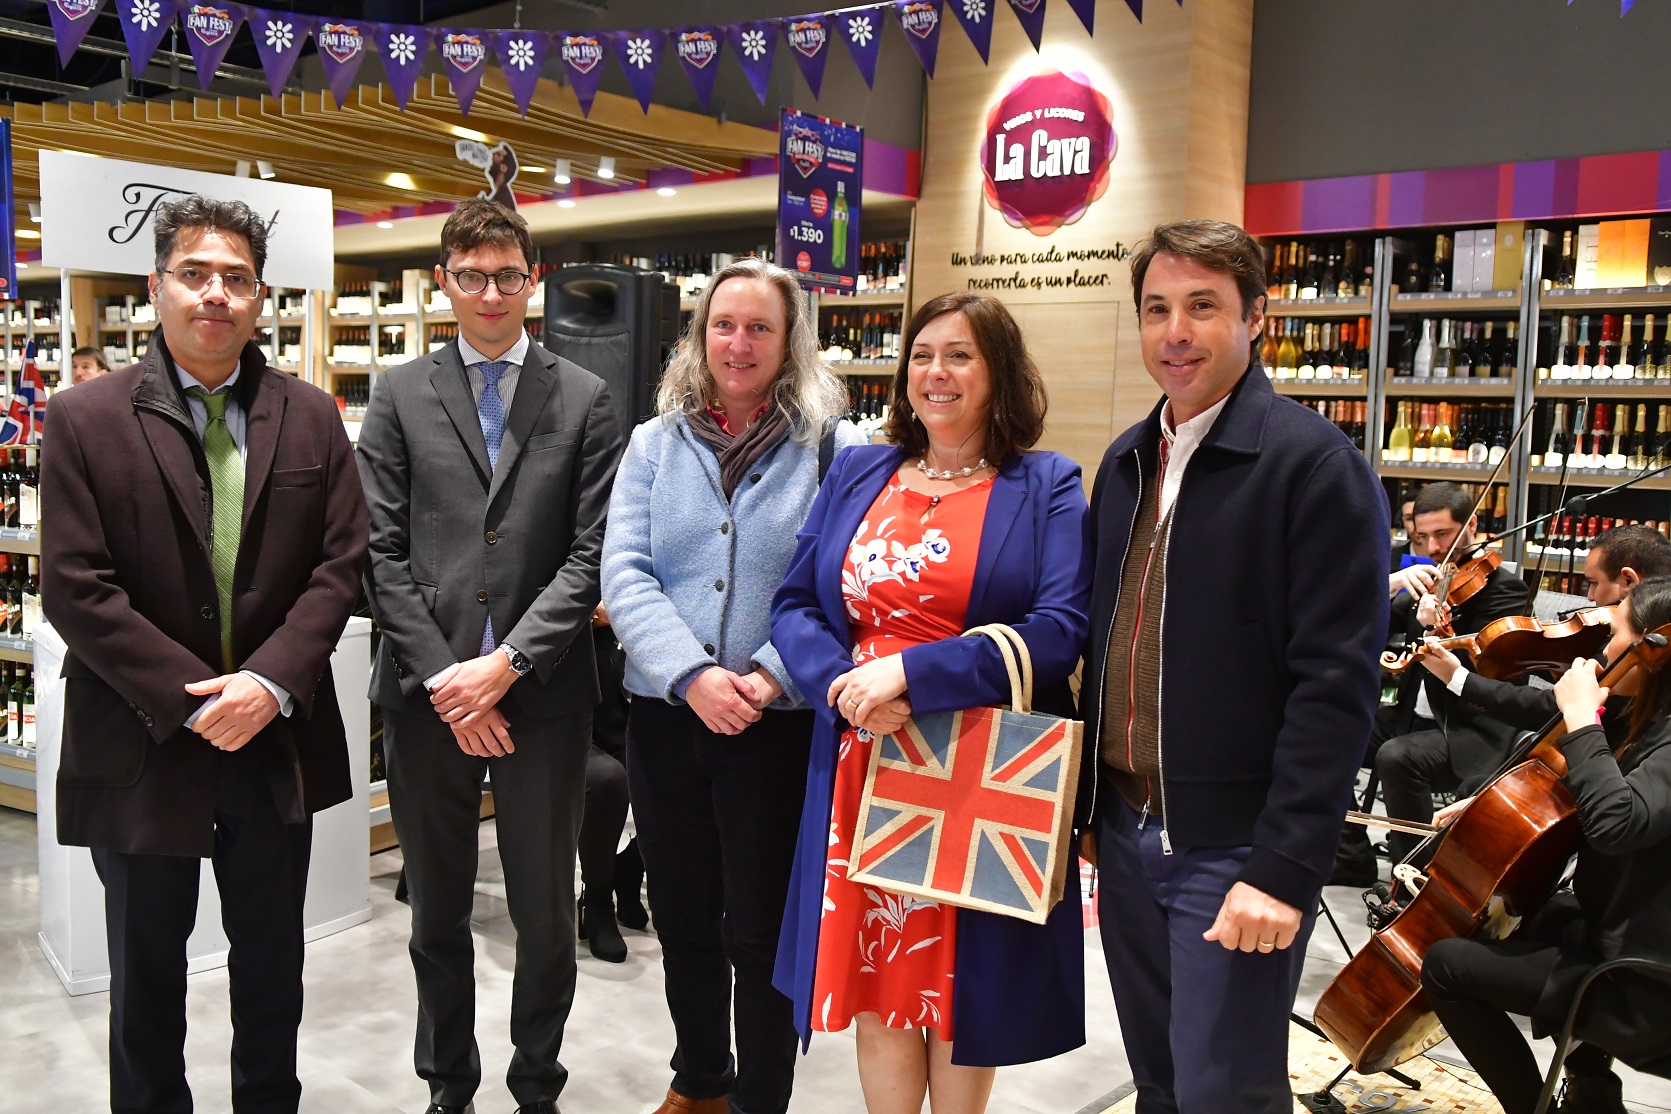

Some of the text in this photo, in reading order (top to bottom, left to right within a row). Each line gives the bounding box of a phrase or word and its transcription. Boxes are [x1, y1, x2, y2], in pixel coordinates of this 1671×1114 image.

[190, 15, 230, 31] FAN FEST
[905, 11, 936, 26] FAN FEST
[321, 33, 361, 47] FAN FEST
[791, 29, 824, 43] FAN FEST
[445, 44, 483, 57] FAN FEST
[564, 45, 600, 58] FAN FEST
[681, 40, 716, 54] FAN FEST
[1002, 107, 1085, 131] VINOS Y LICORES
[789, 139, 804, 152] FAN
[804, 140, 823, 163] FEST
[994, 129, 1091, 182] La Cava
[790, 225, 824, 244] $1.390
[951, 241, 1130, 266] Un vno para cada momento
[967, 269, 1111, 290] recorrerla es un placer.
